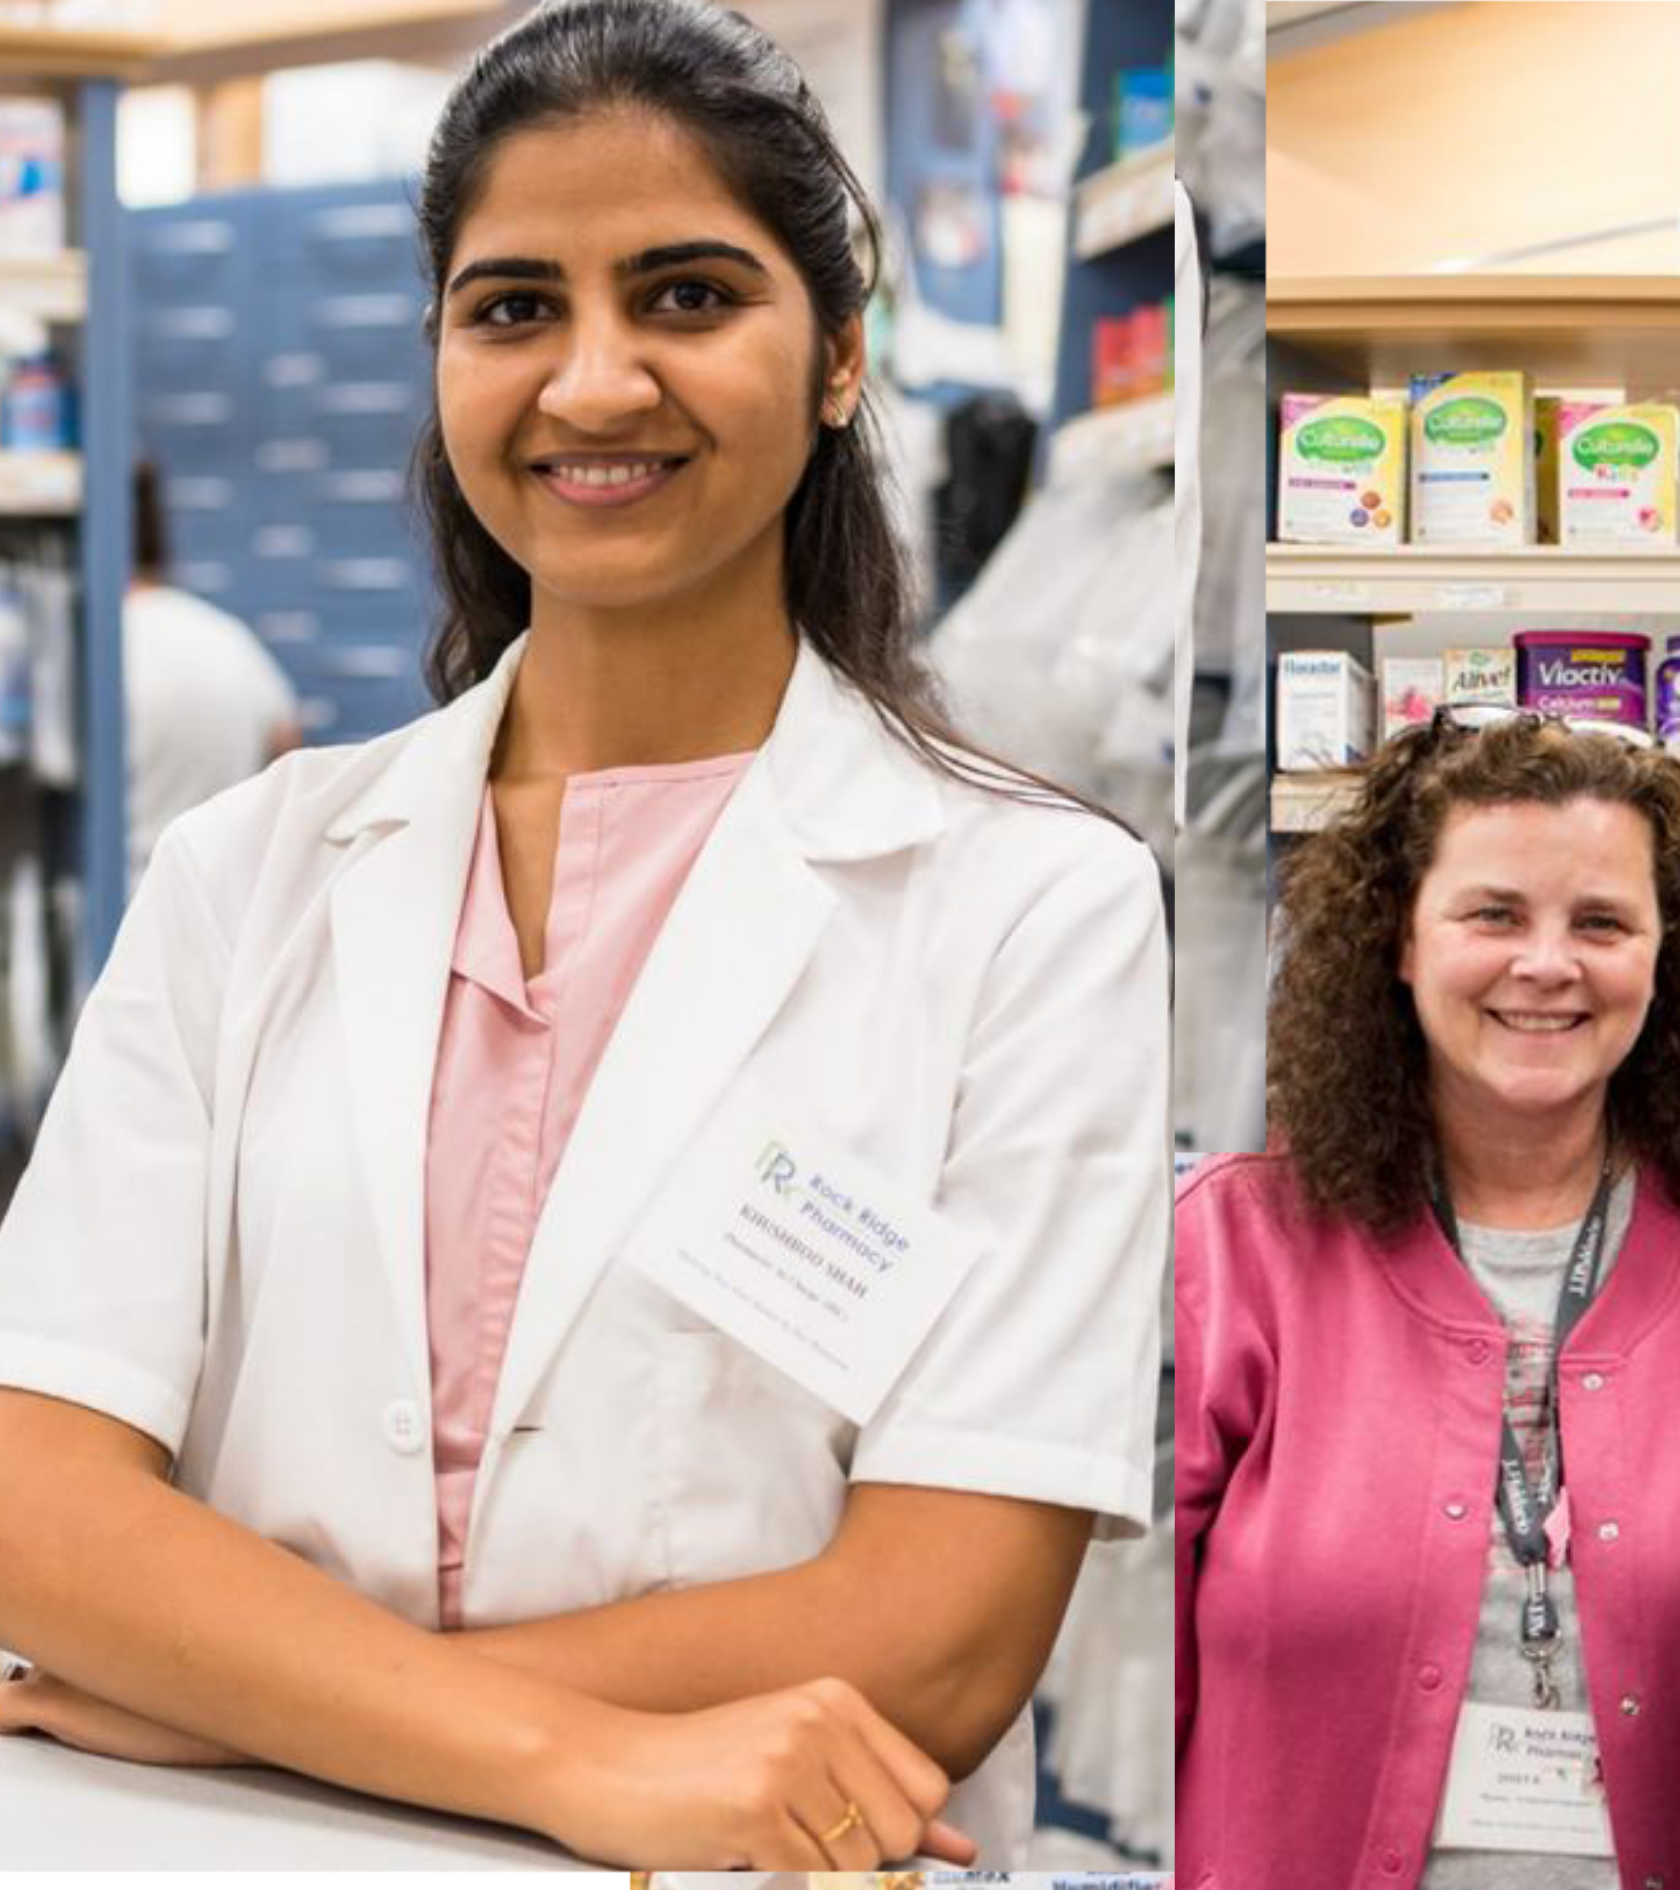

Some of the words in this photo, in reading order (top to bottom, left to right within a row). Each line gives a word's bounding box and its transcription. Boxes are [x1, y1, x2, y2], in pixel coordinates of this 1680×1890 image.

[1539, 658, 1623, 686] Viactiv
[799, 1200, 895, 1274] Pharmacy
[808, 1173, 854, 1213] Rock
[858, 1206, 911, 1253] Ridge
